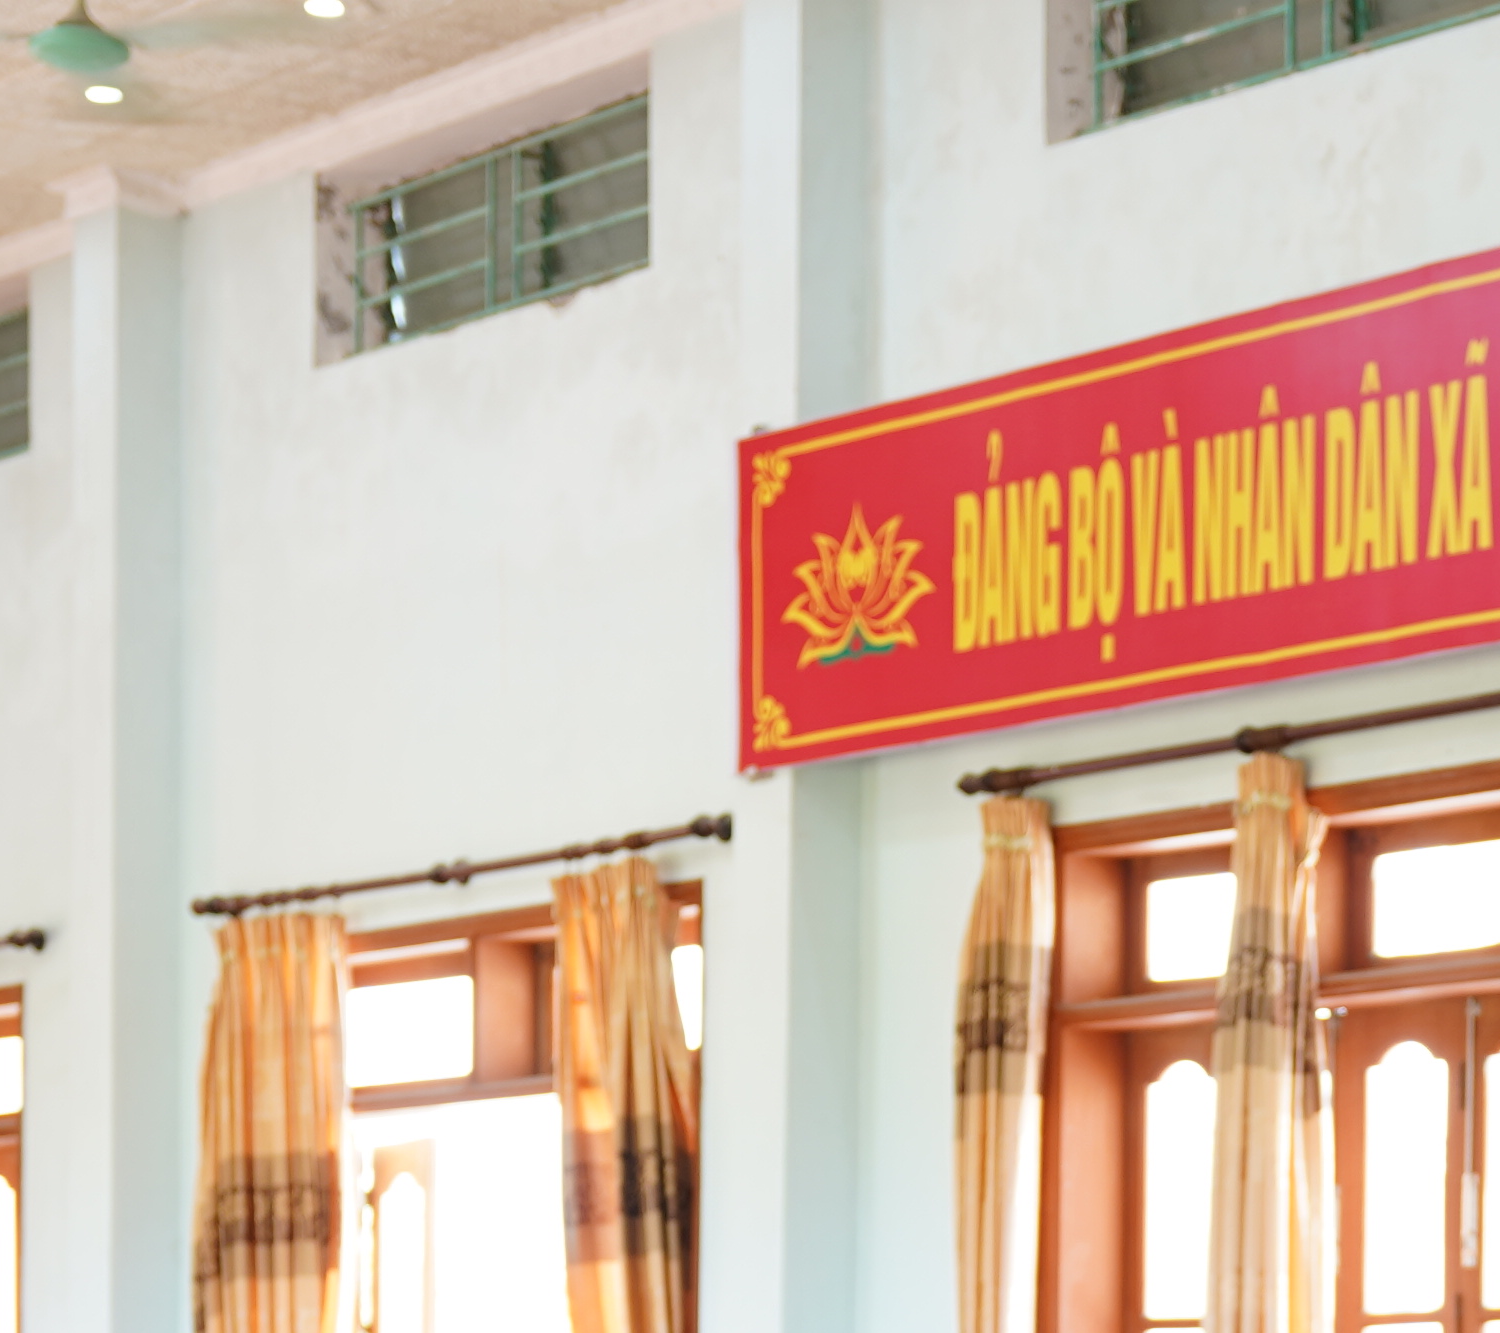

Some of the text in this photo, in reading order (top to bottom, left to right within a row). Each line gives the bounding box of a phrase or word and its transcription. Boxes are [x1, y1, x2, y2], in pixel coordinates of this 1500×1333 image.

[953, 429, 1062, 651] ĐẢNG
[1067, 422, 1123, 661] BỘ
[1131, 409, 1186, 614] VÀ
[1193, 385, 1315, 603] NHÂN
[1324, 361, 1419, 580] DÂN
[1427, 338, 1493, 560] XÃ
